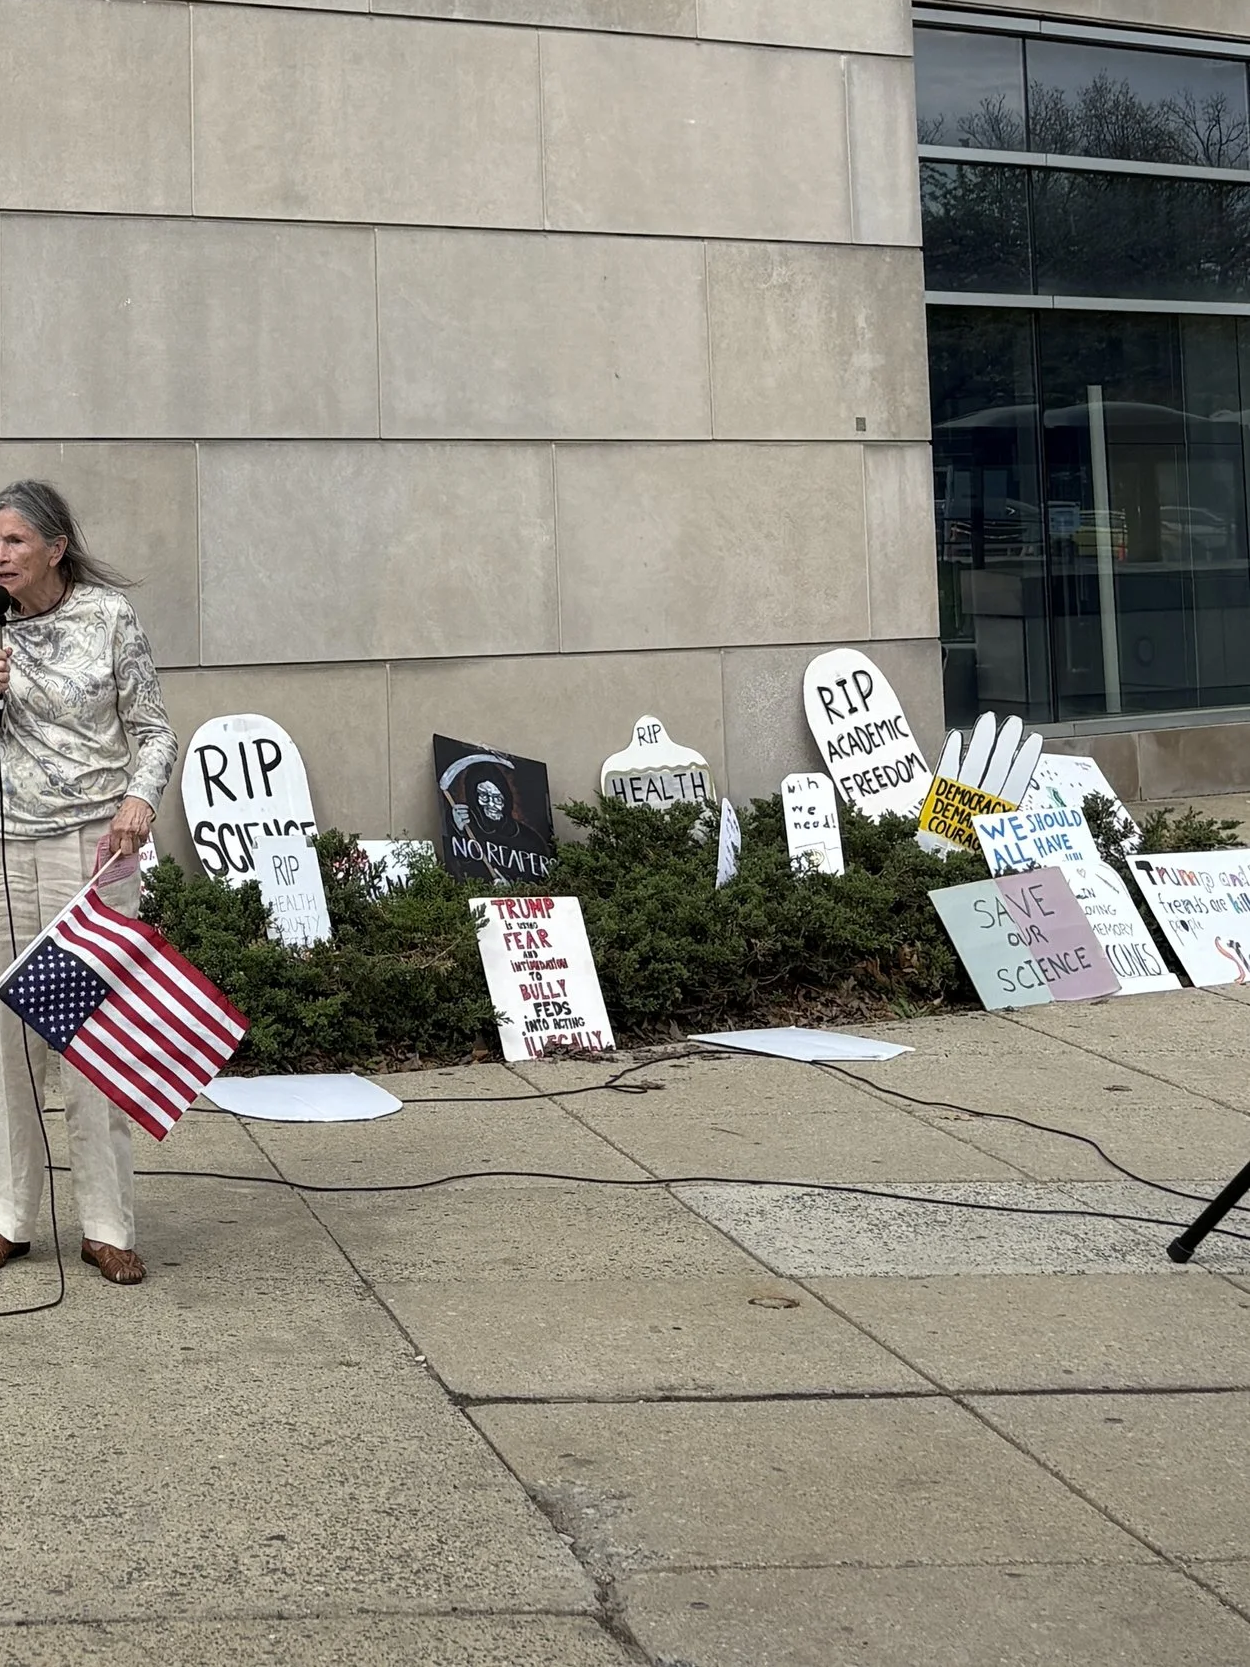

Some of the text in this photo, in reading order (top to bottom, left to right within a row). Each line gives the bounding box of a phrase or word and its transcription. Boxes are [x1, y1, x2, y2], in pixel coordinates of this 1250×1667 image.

[817, 670, 873, 725] RIP
[636, 723, 661, 746] RIP
[826, 715, 909, 763] ACADEMIC
[194, 738, 282, 807] RIP
[612, 771, 706, 803] HEALTH
[840, 752, 928, 799] FREEDOM
[932, 797, 974, 828] DEMA
[979, 809, 1082, 841] WE SHOULD
[193, 819, 315, 876] SCIE
[451, 836, 484, 861] NO
[928, 816, 982, 851] COURAG
[993, 833, 1073, 872] ALL HAVE
[272, 855, 299, 886] RIP
[1134, 860, 1215, 893] Trump
[268, 893, 318, 913] HEALTH
[490, 898, 555, 919] TRUMP
[973, 884, 1055, 929] SAVE
[1084, 904, 1117, 916] OVING
[503, 928, 553, 951] FEAR
[1007, 924, 1049, 947] OUR
[523, 950, 538, 959] AND
[997, 946, 1092, 992] SCIENCE
[1105, 942, 1162, 978] CCINES
[519, 979, 568, 1001] BULLY
[529, 972, 543, 982] TO
[533, 1001, 572, 1018] FEDS
